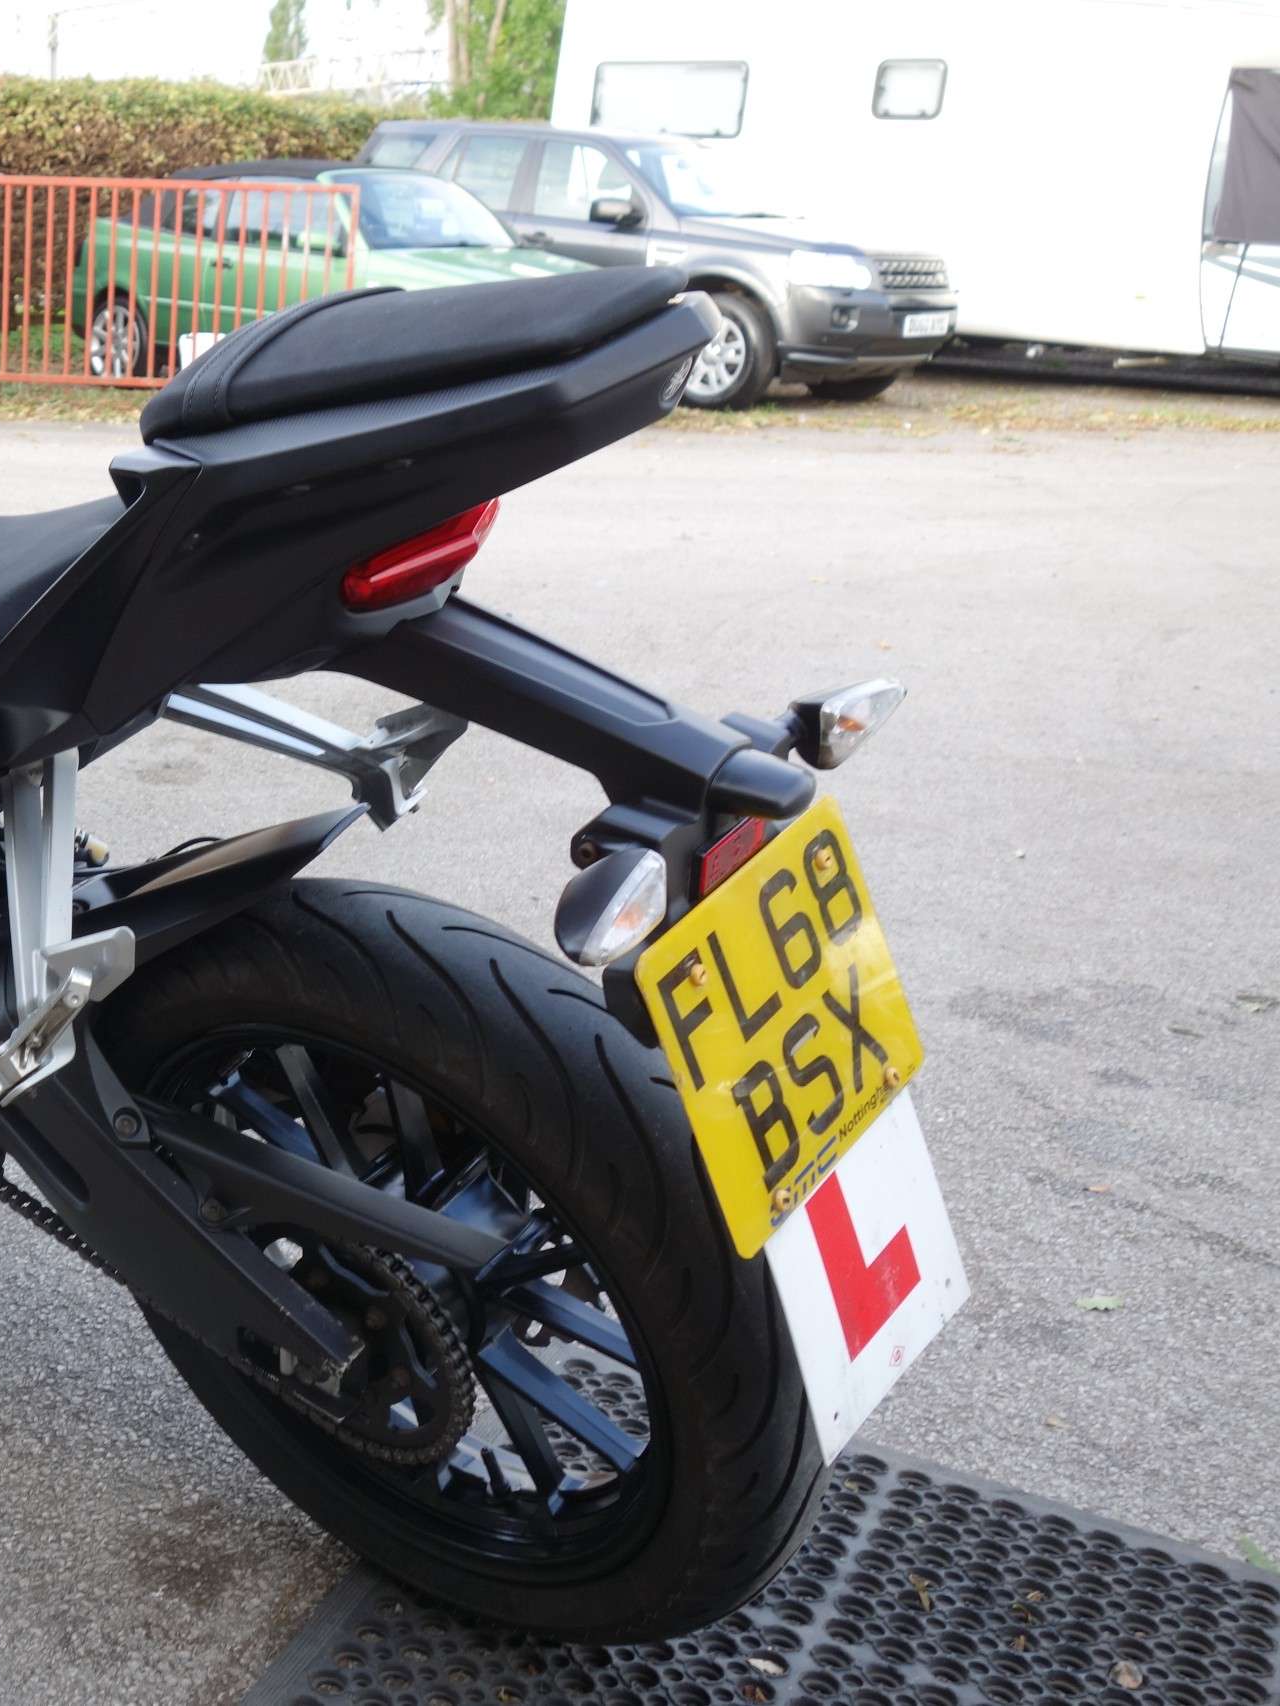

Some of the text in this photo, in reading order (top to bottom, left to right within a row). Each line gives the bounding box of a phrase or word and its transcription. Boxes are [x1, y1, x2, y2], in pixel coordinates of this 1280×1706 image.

[657, 827, 863, 1092] FL68
[732, 963, 889, 1194] BSX
[838, 1082, 890, 1142] Nottingh
[804, 1169, 921, 1363] L
